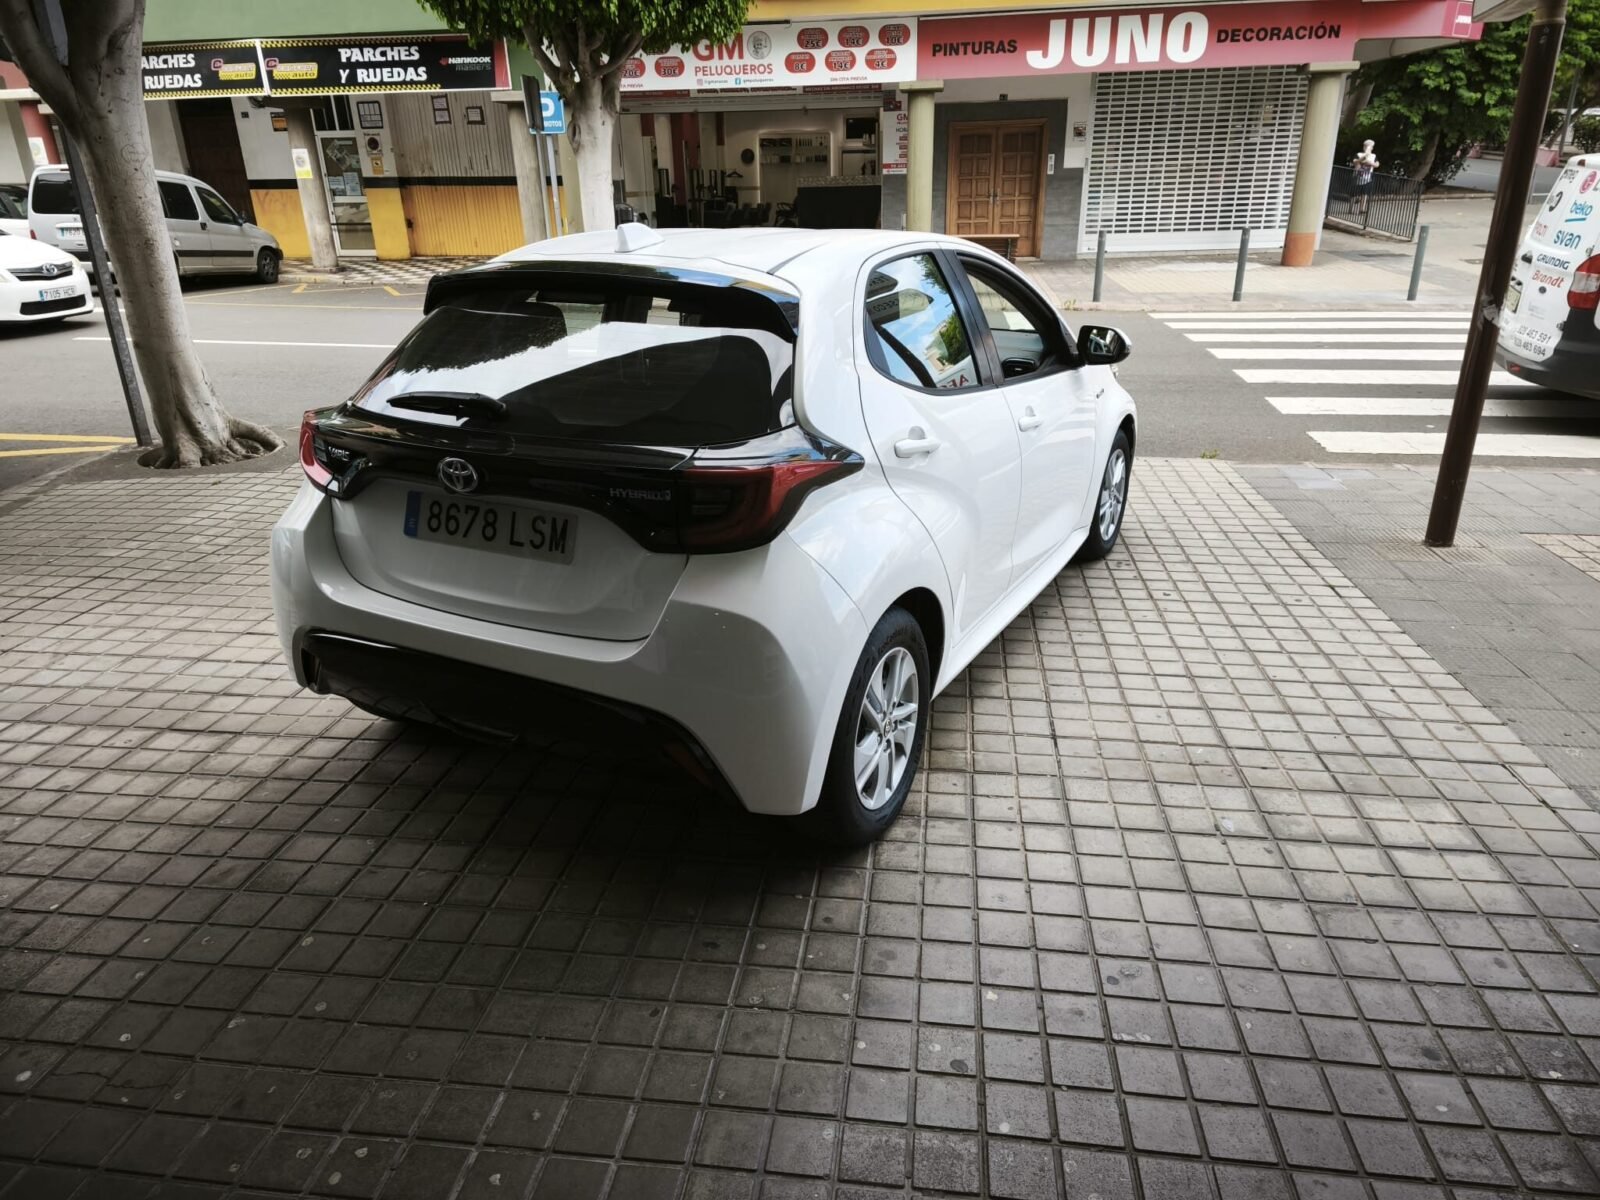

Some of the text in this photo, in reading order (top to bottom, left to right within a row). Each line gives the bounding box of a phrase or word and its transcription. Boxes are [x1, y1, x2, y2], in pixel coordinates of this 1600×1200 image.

[692, 32, 744, 62] GM
[932, 11, 1342, 70] PINTURAS JUNO DECORACIÓN
[141, 53, 196, 70] ARCHES
[338, 45, 421, 63] PARCHES
[338, 67, 428, 84] Y RUEDAS
[694, 63, 774, 78] PELUQUEROS
[144, 73, 203, 90] RUEDAS
[1569, 199, 1594, 217] beko
[1553, 229, 1582, 250] svan
[1536, 253, 1571, 271] GRUNDIG
[1531, 270, 1565, 289] Brandt
[426, 500, 569, 555] 8678 LSM
